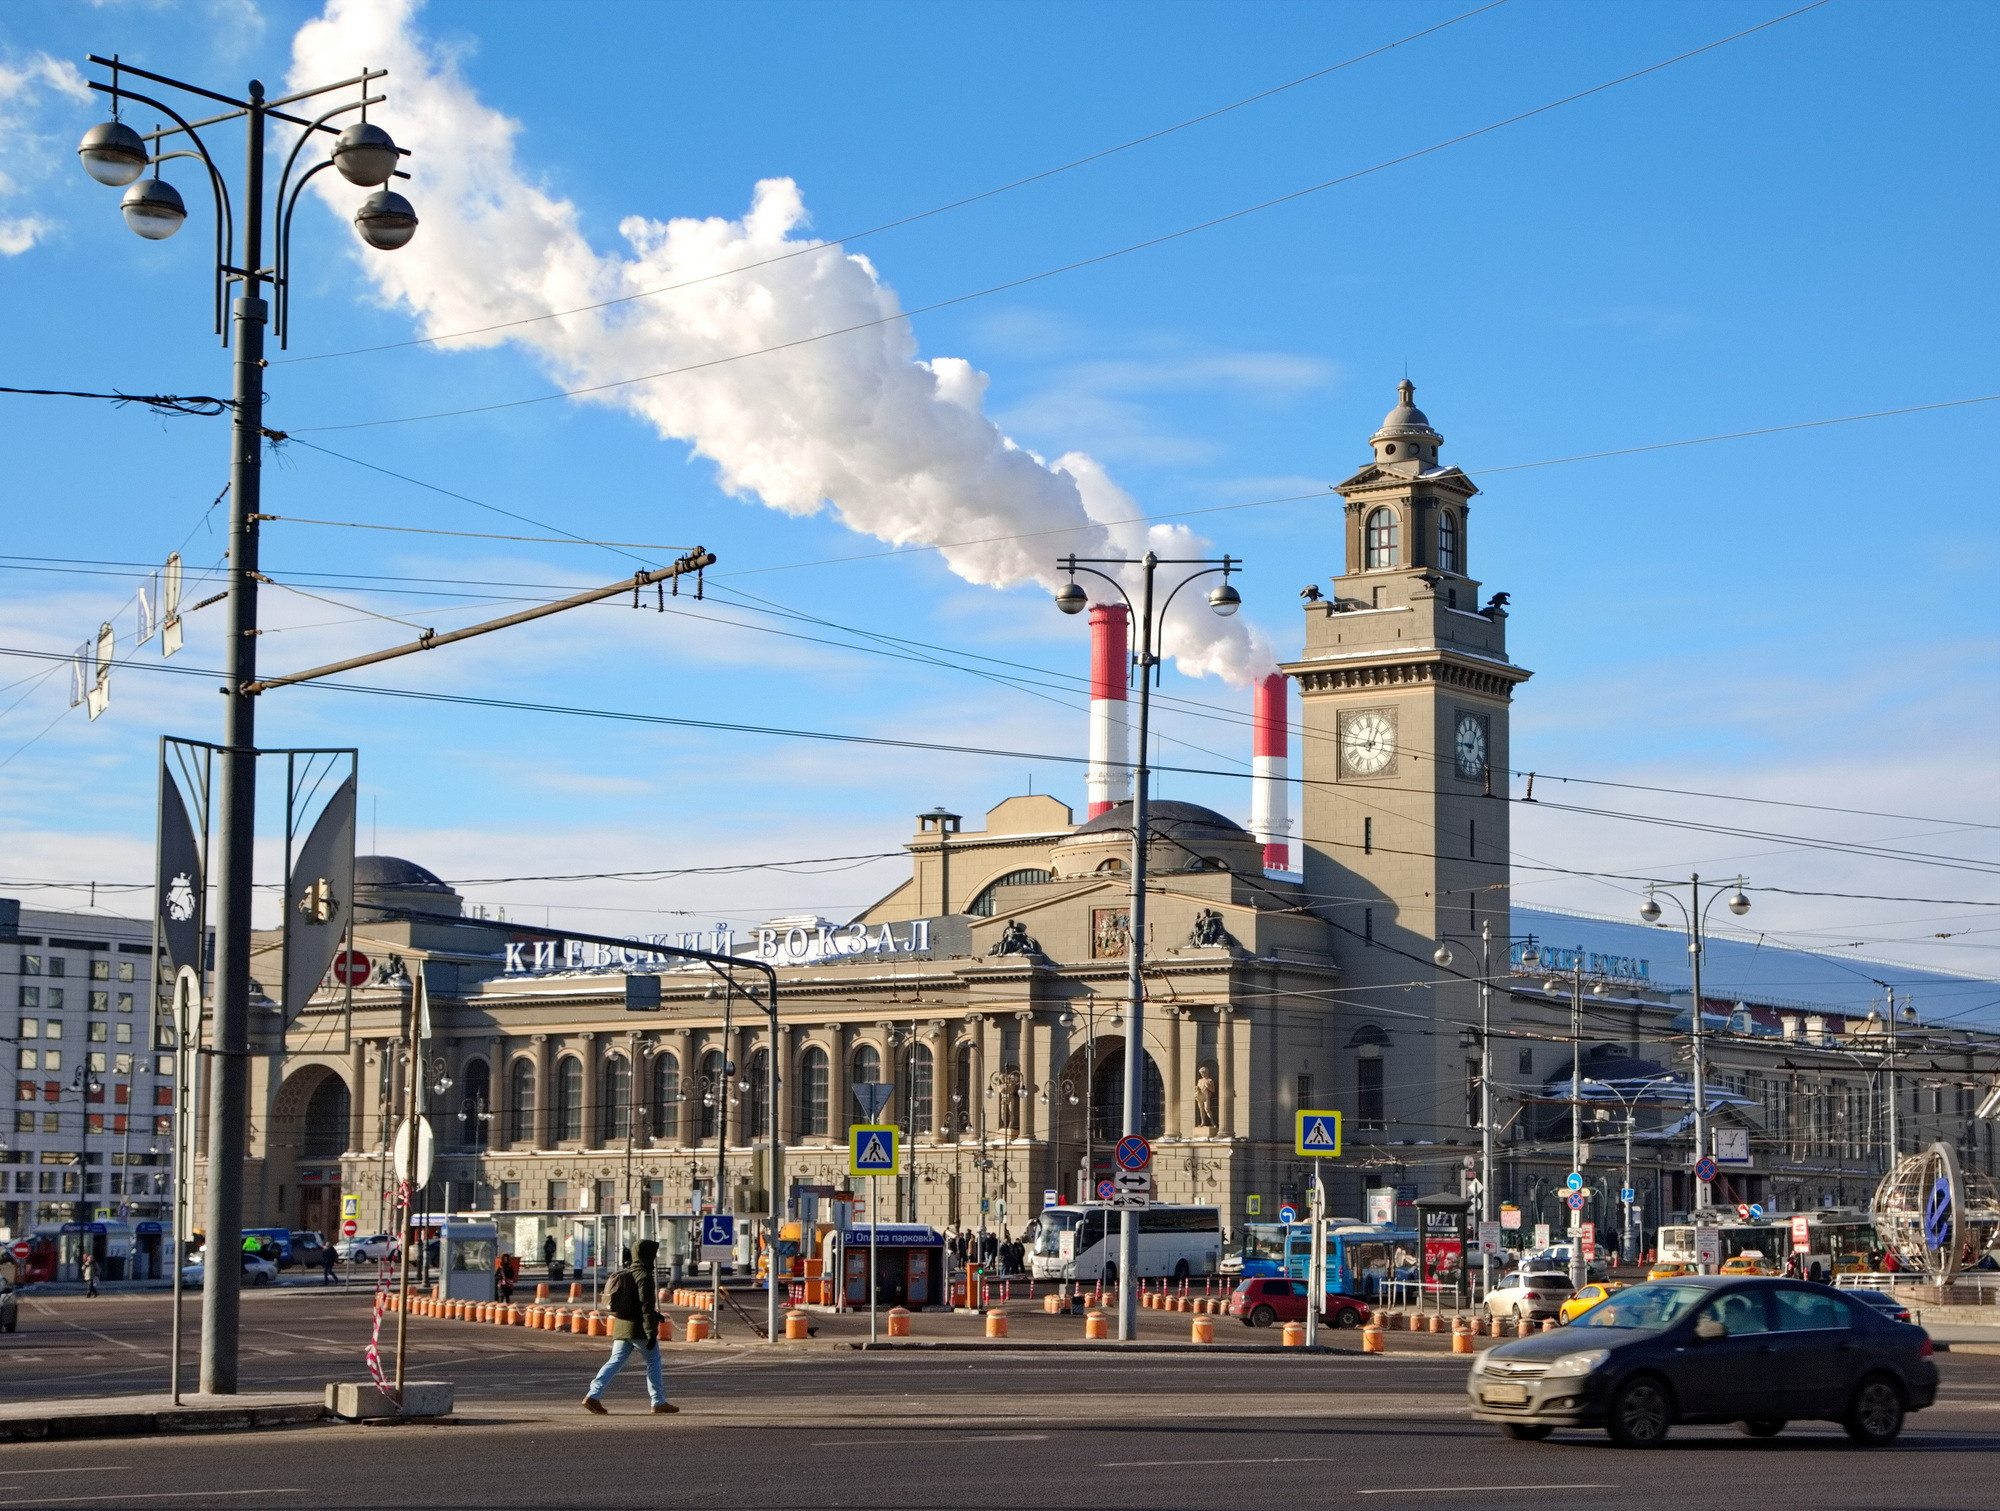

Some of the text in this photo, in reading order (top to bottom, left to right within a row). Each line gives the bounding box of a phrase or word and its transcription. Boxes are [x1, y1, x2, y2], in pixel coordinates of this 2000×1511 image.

[504, 920, 931, 972] КИЕВСКИЙ ВОКЗАЛ
[1590, 953, 1650, 980] ВОКЗАЛ
[892, 1235, 935, 1244] парковки
